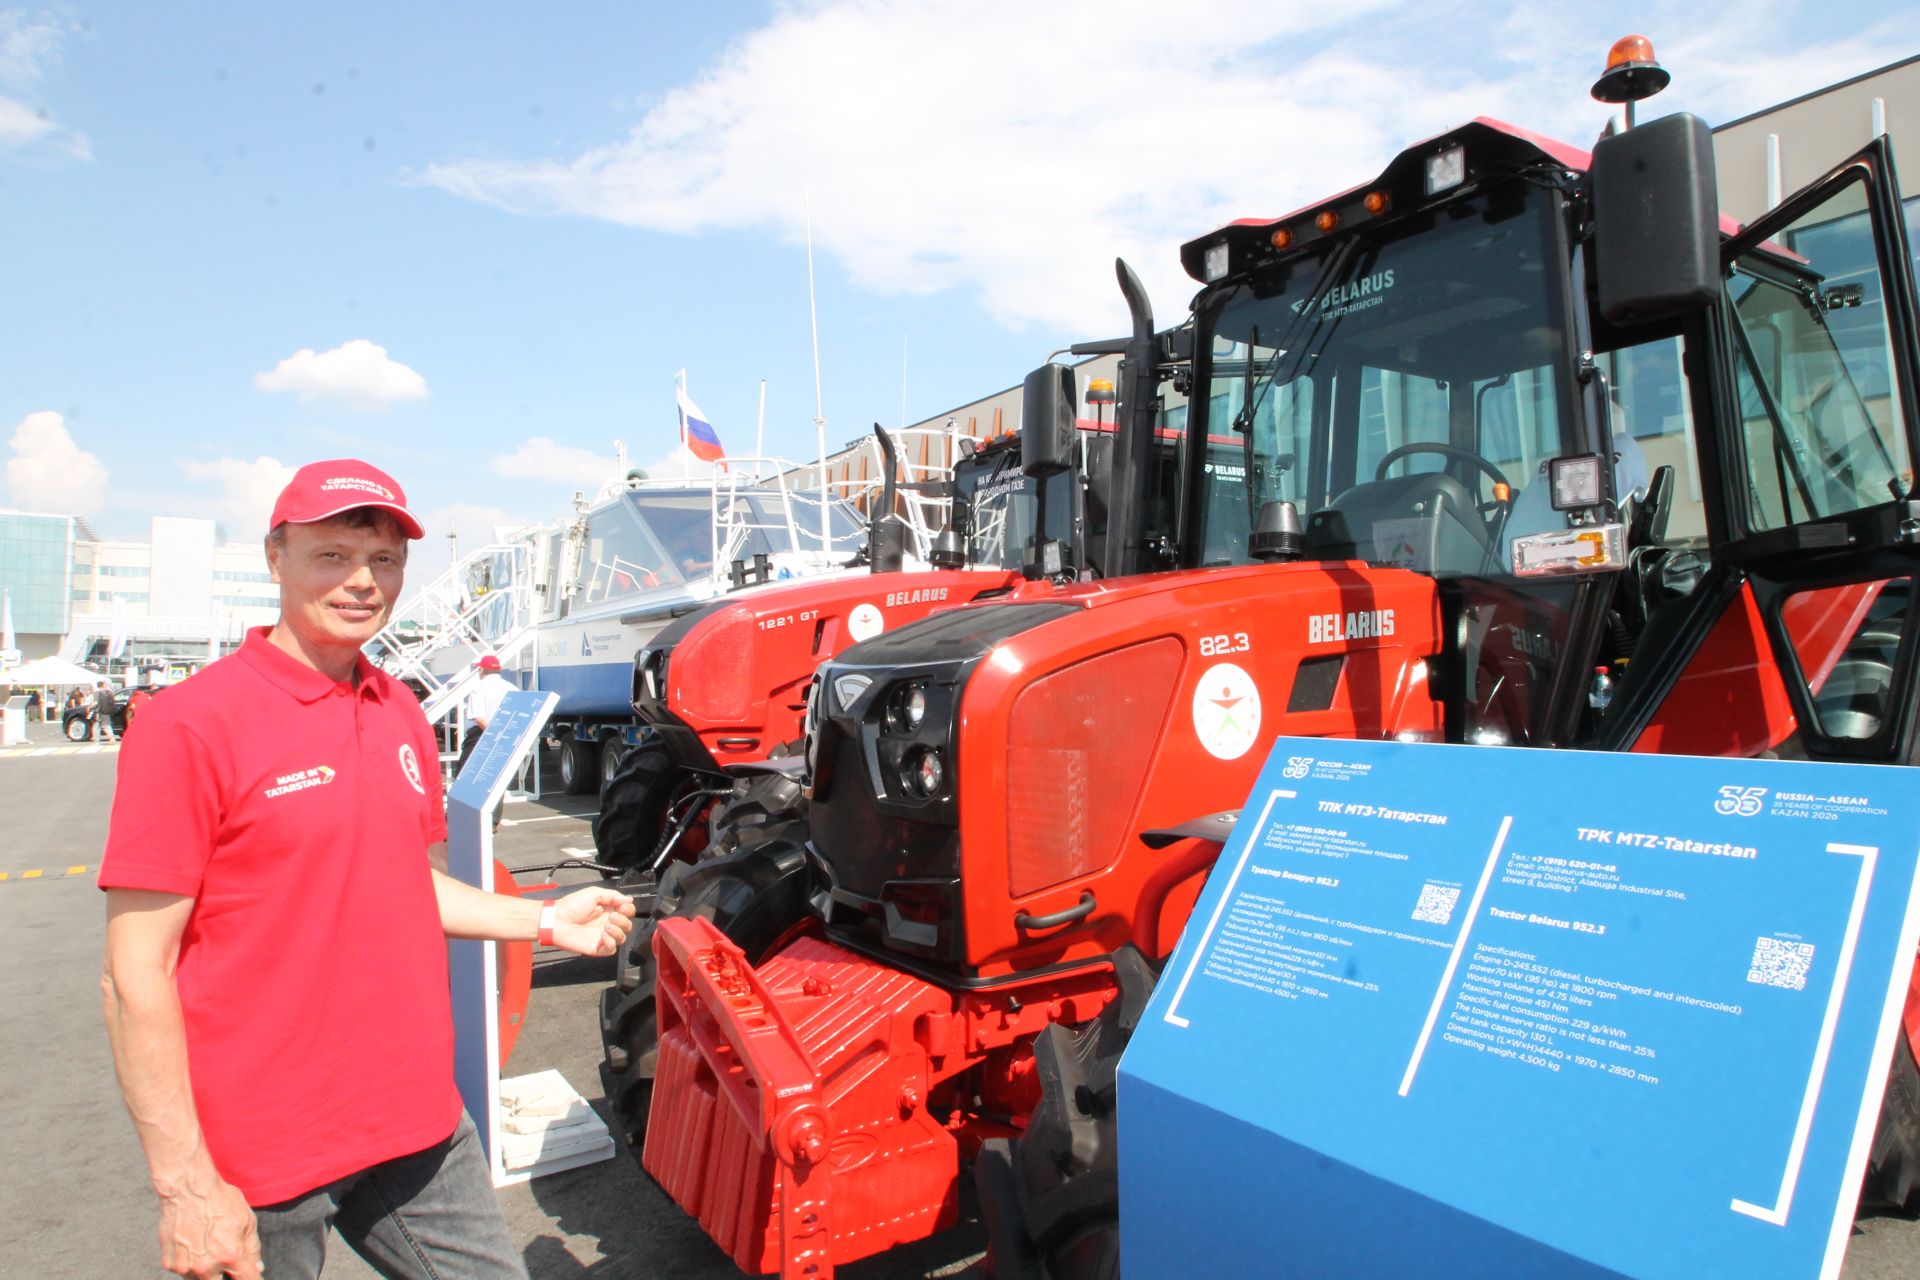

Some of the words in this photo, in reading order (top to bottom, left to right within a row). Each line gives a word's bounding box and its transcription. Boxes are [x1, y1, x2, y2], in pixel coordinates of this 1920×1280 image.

[1321, 269, 1395, 309] BELARUS
[326, 478, 376, 487] СДЕЛАНО
[978, 476, 985, 485] НА
[1215, 464, 1246, 477] BELARUS
[321, 484, 384, 496] ТАТАРСТАНЕ
[1011, 480, 1024, 491] ГАЗЕ
[886, 587, 948, 607] BELARUS
[758, 617, 795, 631] 1221
[800, 610, 819, 622] GT
[1309, 609, 1395, 644] BELARUS
[1199, 632, 1250, 657] 82.3
[264, 777, 321, 798] TATARSTAN
[276, 771, 306, 785] MADE
[307, 768, 318, 777] IN
[1318, 800, 1344, 813] ТПК
[1344, 803, 1447, 824] МТЗ-Татарстан
[1770, 808, 1809, 818] KAZAN
[1811, 811, 1839, 820] 2026
[1784, 801, 1810, 810] YEARS
[1823, 804, 1888, 815] COOPERATION
[1577, 827, 1613, 843] TPK
[1616, 832, 1758, 859] MTZ-Tatarstan
[1251, 865, 1282, 878] Трактор
[1281, 870, 1316, 883] Беларус
[1501, 876, 1527, 885] street
[1536, 880, 1572, 893] building
[1506, 867, 1543, 880] Yelabuga
[1576, 878, 1617, 890] Alabuga
[1618, 883, 1664, 896] Industrial
[1490, 907, 1527, 921] Tractor
[1528, 913, 1570, 928] Belarus
[1572, 921, 1606, 934] 952.3
[1476, 943, 1536, 961] Specifications:
[1466, 972, 1501, 987] Working
[1502, 981, 1535, 994] volume
[1535, 988, 1548, 996] of
[1568, 994, 1592, 1006] liters
[1468, 963, 1508, 976] power70
[1507, 970, 1524, 980] kW
[1524, 974, 1540, 984] (95
[1541, 977, 1558, 988] hp)
[1558, 982, 1570, 990] at
[1571, 983, 1596, 995] 1800
[1596, 990, 1617, 1000] rpm
[1473, 952, 1502, 965] Engine
[1584, 975, 1652, 996] turbocharged
[1652, 990, 1674, 1000] and
[1675, 995, 1742, 1015] intercooled)
[1462, 982, 1503, 997] Maximum
[1503, 992, 1533, 1005] torque
[1534, 999, 1551, 1008] 451
[1551, 1002, 1569, 1013] Nm
[1458, 991, 1491, 1006] Specific
[1492, 999, 1510, 1010] fuel
[1510, 1005, 1570, 1024] consumption
[1570, 1018, 1590, 1030] 229
[1591, 1024, 1626, 1038] g/kWh
[1450, 1011, 1469, 1022] Fuel
[1470, 1017, 1489, 1028] tank
[1490, 1023, 1528, 1039] capacity
[1530, 1031, 1546, 1043] 130
[1455, 1001, 1471, 1012] The
[1471, 1006, 1500, 1020] torque
[1500, 1014, 1535, 1028] reserve
[1535, 1023, 1557, 1034] ratio
[1568, 1031, 1586, 1040] not
[1587, 1034, 1606, 1046] less
[1608, 1040, 1632, 1052] than
[1633, 1045, 1656, 1058] 25%
[1443, 1032, 1485, 1051] Operating
[1486, 1045, 1517, 1059] weight
[1547, 1060, 1560, 1072] kg
[1446, 1022, 1495, 1041] Dimensions
[1574, 1055, 1597, 1068] 1970
[1608, 1064, 1636, 1078] 2850
[1637, 1073, 1659, 1084] mm
